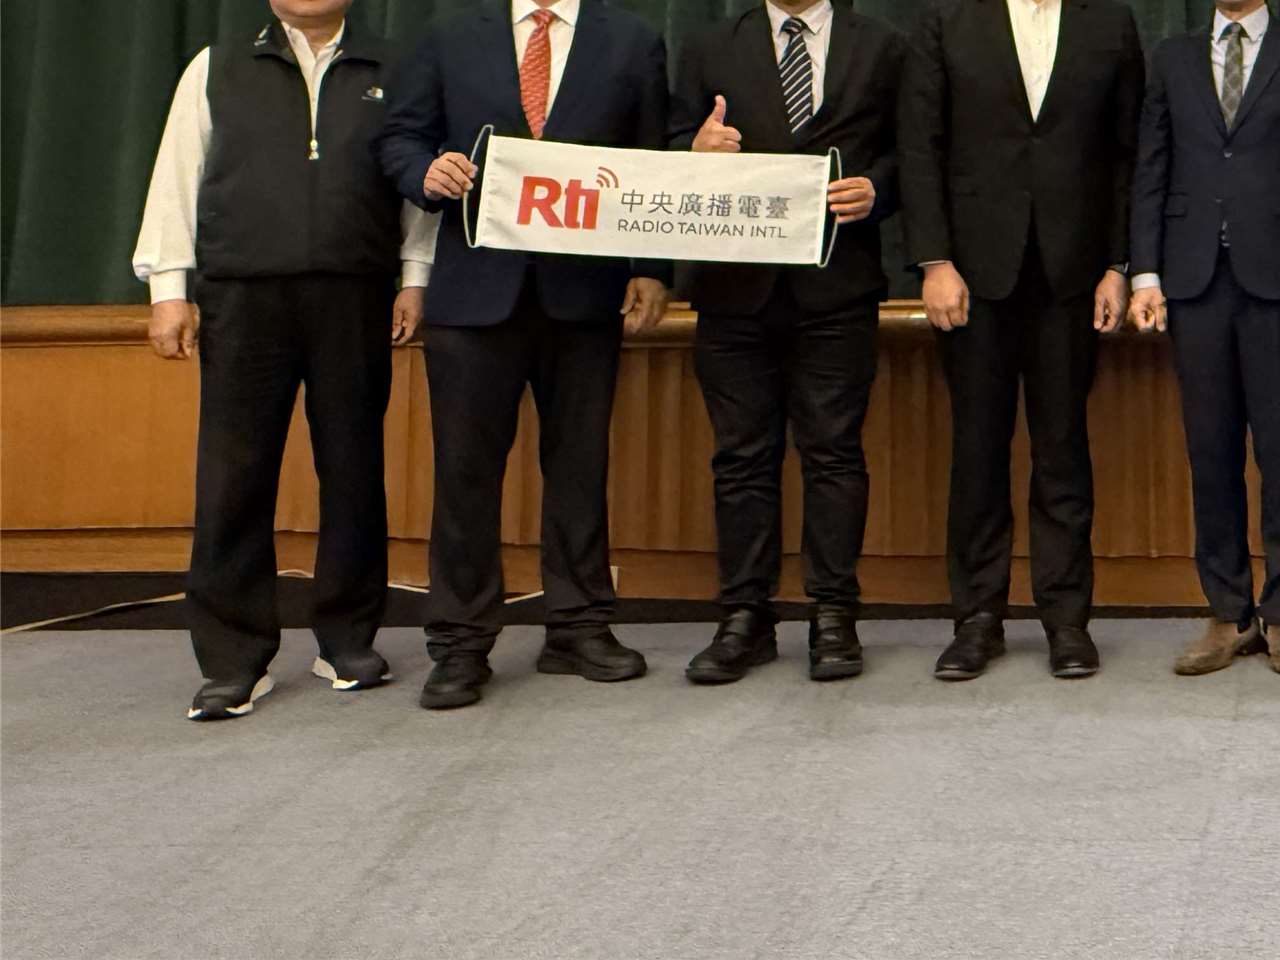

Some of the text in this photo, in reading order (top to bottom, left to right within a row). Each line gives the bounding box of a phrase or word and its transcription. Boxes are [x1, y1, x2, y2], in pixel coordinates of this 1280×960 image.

[620, 189, 793, 221] 中央廣播電臺
[617, 219, 788, 239] RADIO TAIWAN INTL
